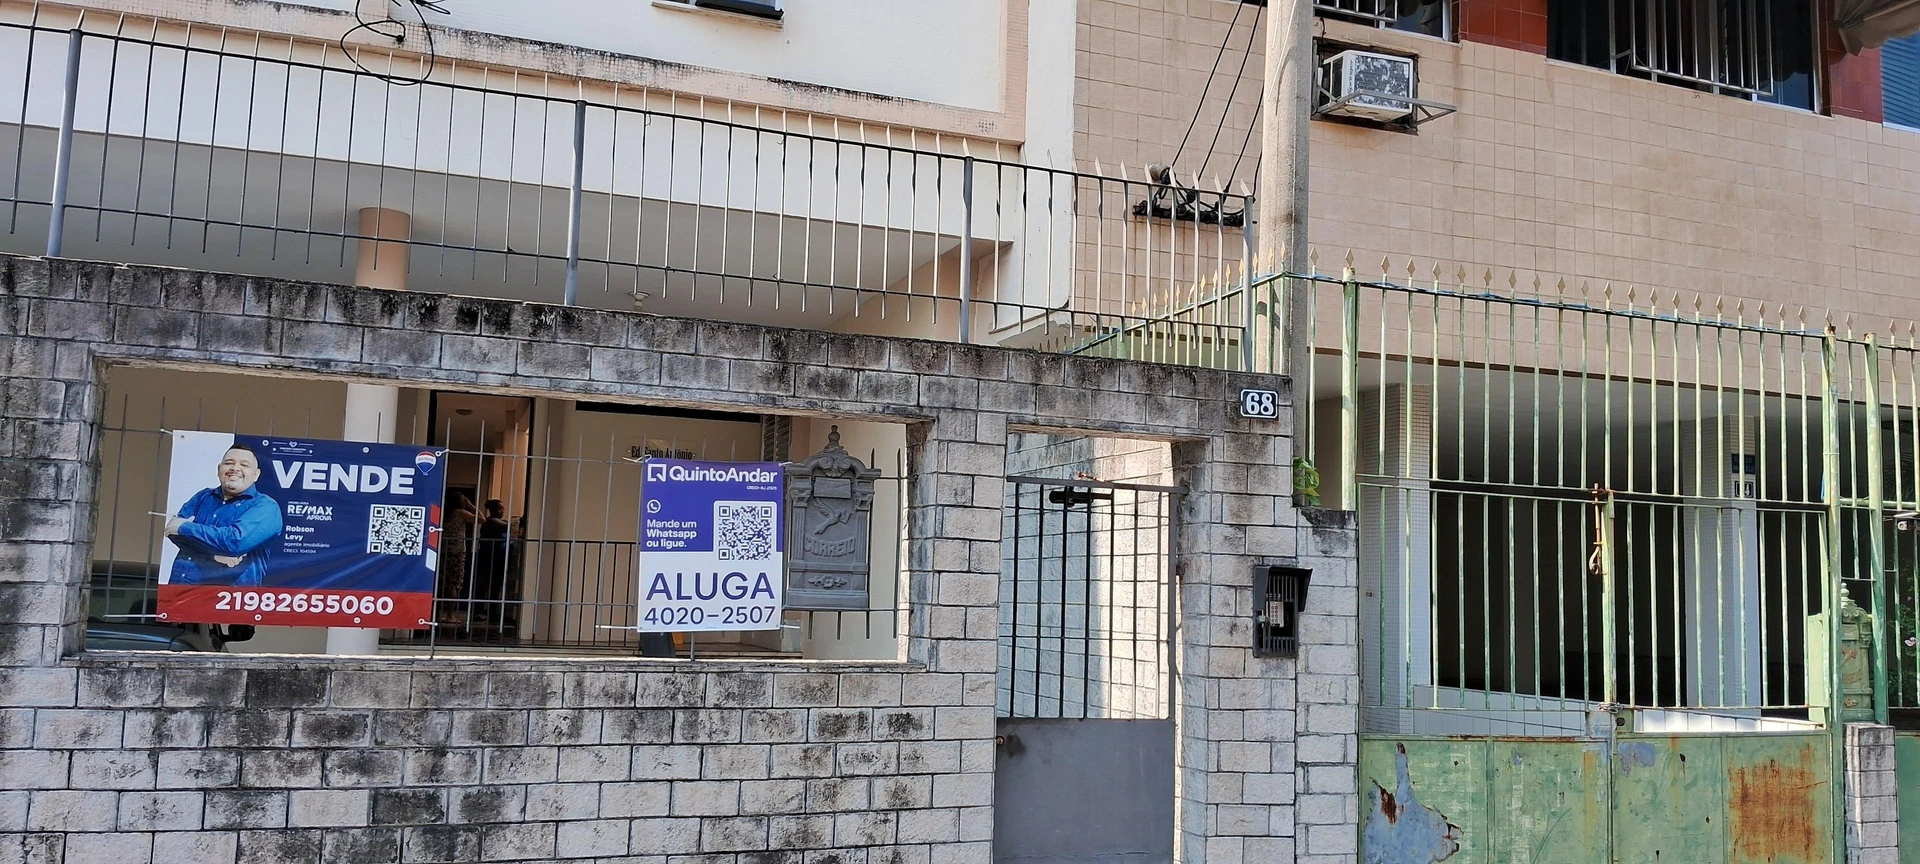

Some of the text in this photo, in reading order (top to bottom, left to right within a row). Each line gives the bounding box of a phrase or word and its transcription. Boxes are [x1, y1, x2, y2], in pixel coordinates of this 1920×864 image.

[1246, 392, 1274, 415] 68
[272, 460, 415, 495] VENDE
[669, 466, 777, 482] QuintoAndar
[287, 505, 333, 515] RE/MAX
[647, 519, 680, 528] Mande
[285, 533, 303, 541] Levy
[647, 529, 697, 540] Whatsapp
[661, 539, 687, 549] ligue.
[804, 536, 857, 557] CORREIO
[646, 572, 775, 600] ALUGA
[215, 591, 394, 615] 21982655060
[644, 606, 776, 625] 4020-2507
